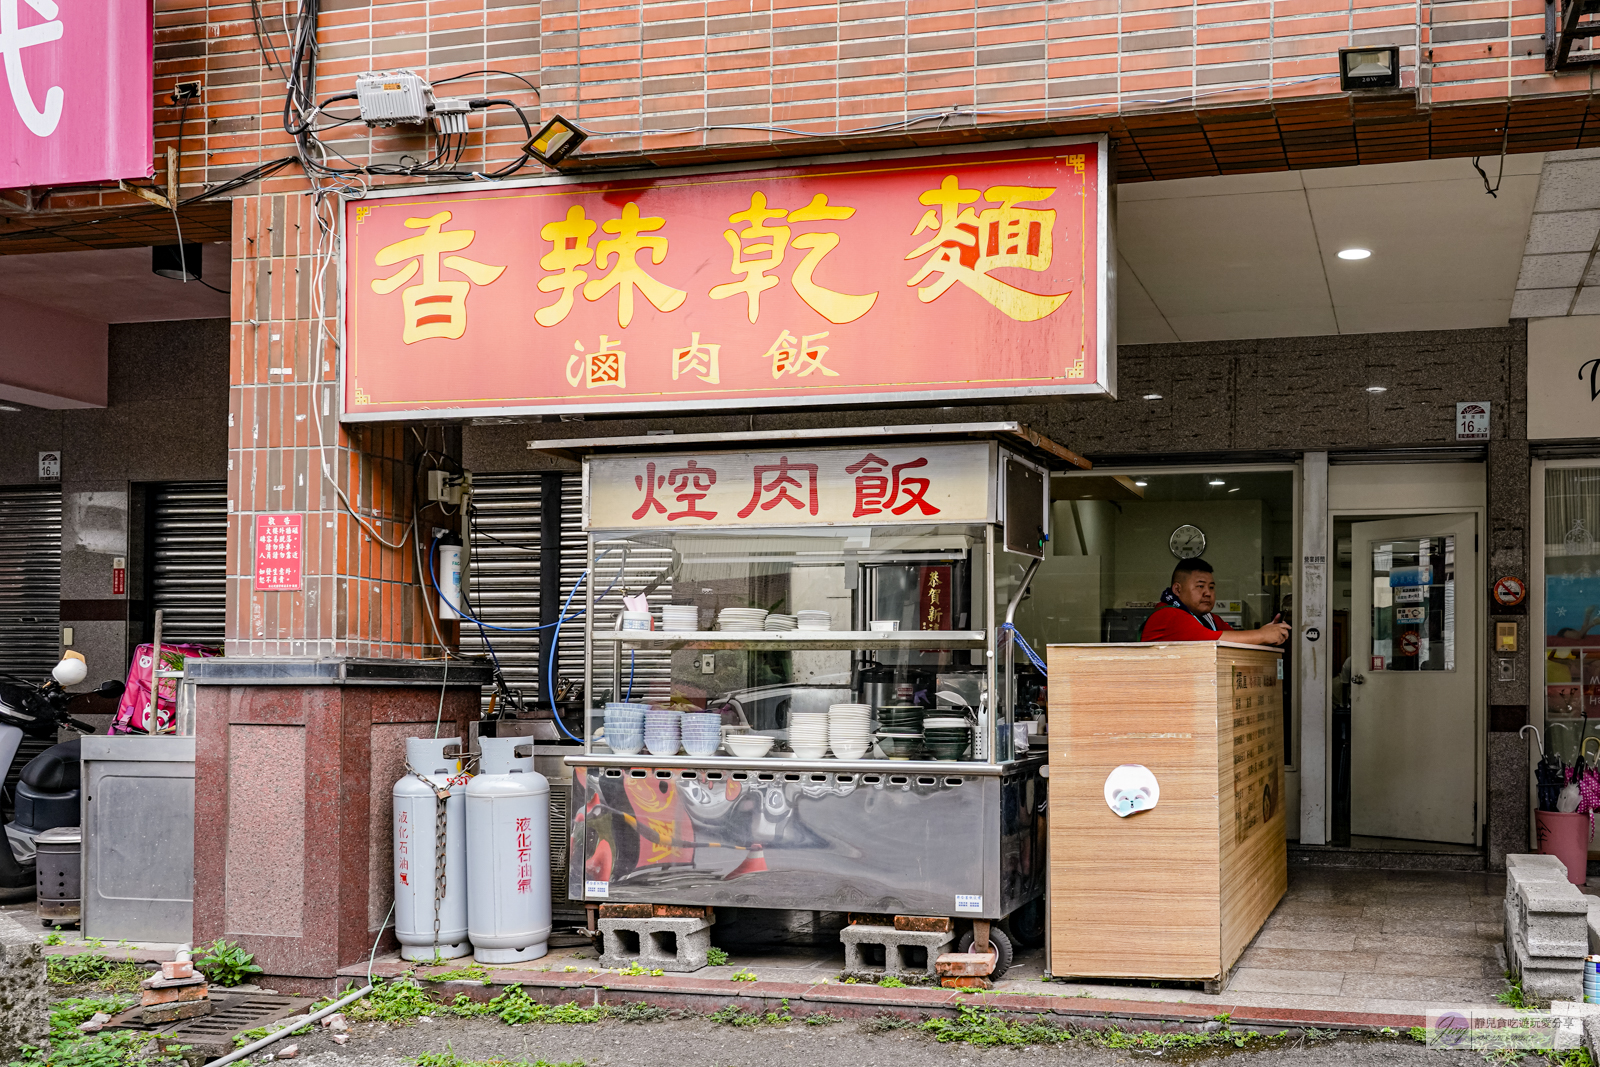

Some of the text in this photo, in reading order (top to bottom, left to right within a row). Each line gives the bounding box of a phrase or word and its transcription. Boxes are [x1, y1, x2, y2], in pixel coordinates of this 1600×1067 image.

[371, 174, 1071, 345] 香辣乾麵
[566, 329, 840, 389] 滷肉飯
[1461, 420, 1474, 432] 16
[41, 465, 51, 476] 16
[631, 453, 942, 522] 焢肉飯
[399, 811, 409, 887] 液化石油氣
[515, 817, 532, 895] 液化石油氣
